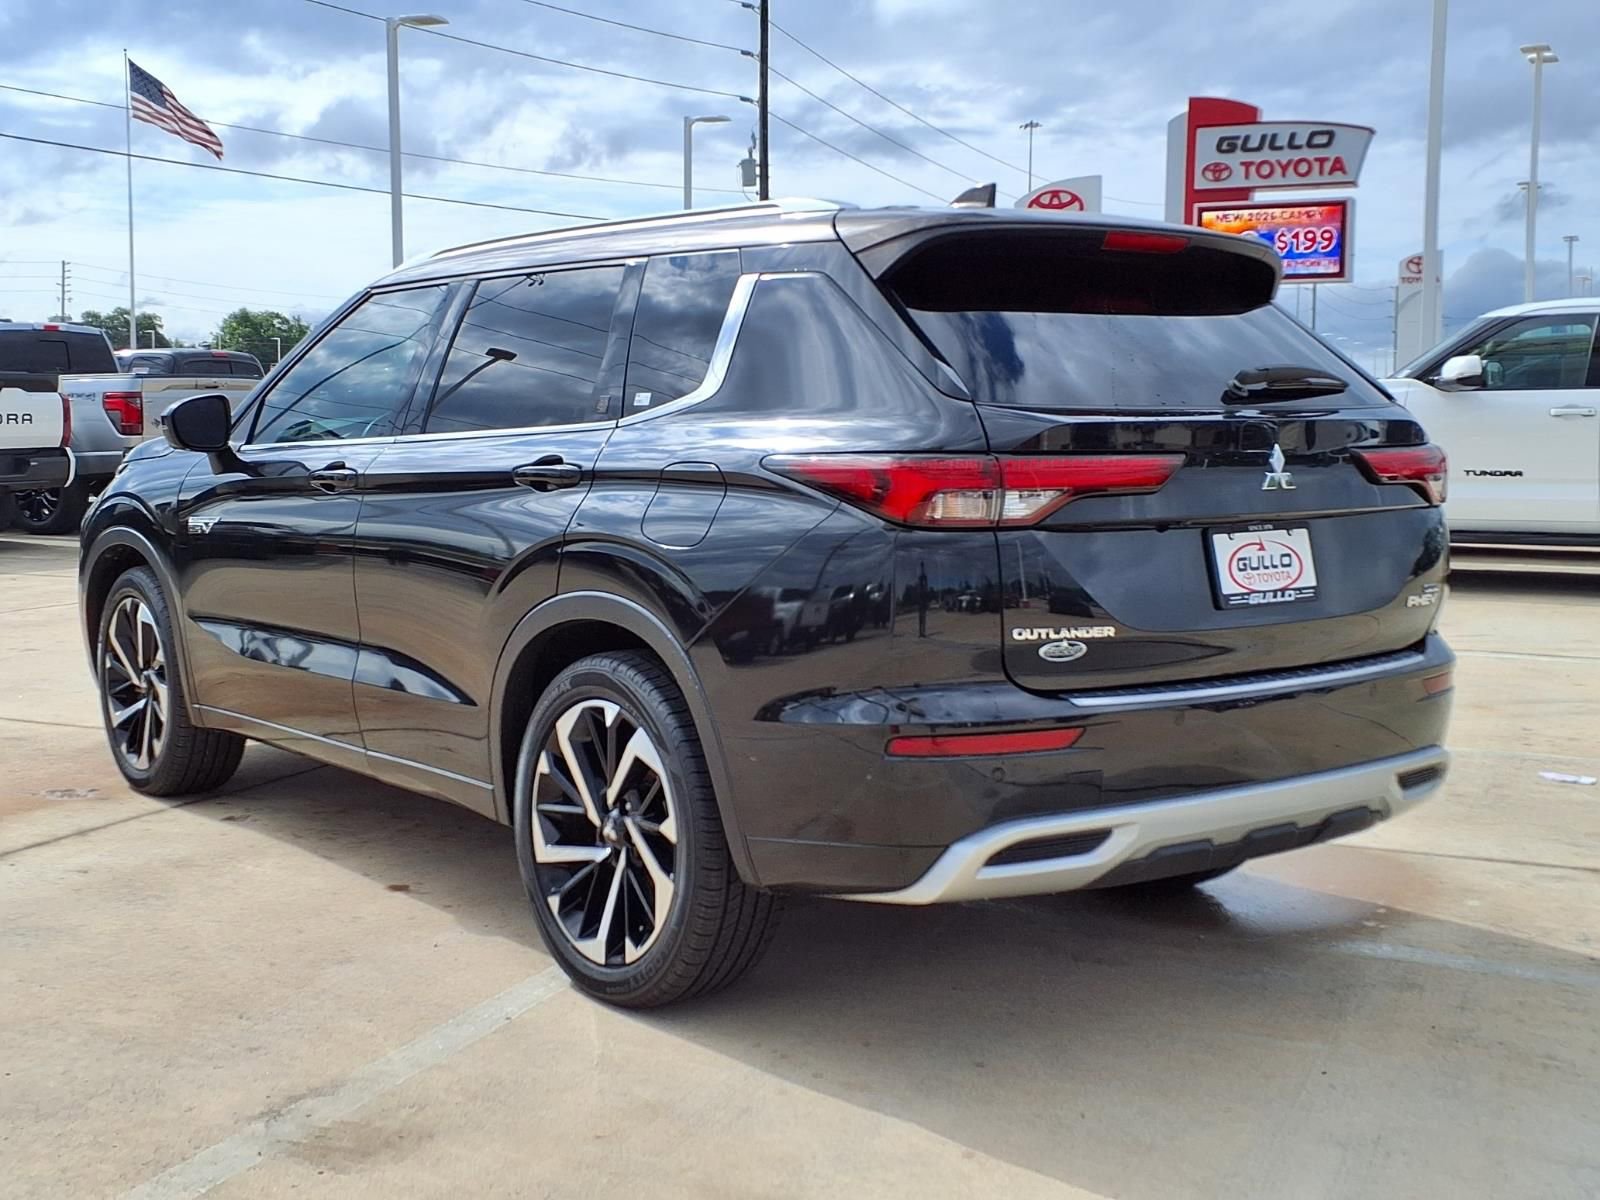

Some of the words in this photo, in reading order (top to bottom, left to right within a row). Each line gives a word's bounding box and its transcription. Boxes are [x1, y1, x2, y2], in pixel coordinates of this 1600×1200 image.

[1216, 129, 1336, 153] GULLO
[1240, 156, 1347, 179] TOYOTA
[1276, 228, 1336, 253] $199
[0, 413, 33, 424] RA
[1237, 553, 1293, 572] GULLO
[1256, 571, 1293, 584] TOYOTA
[1248, 590, 1296, 605] GULLO
[1012, 626, 1116, 641] OUTLANDER
